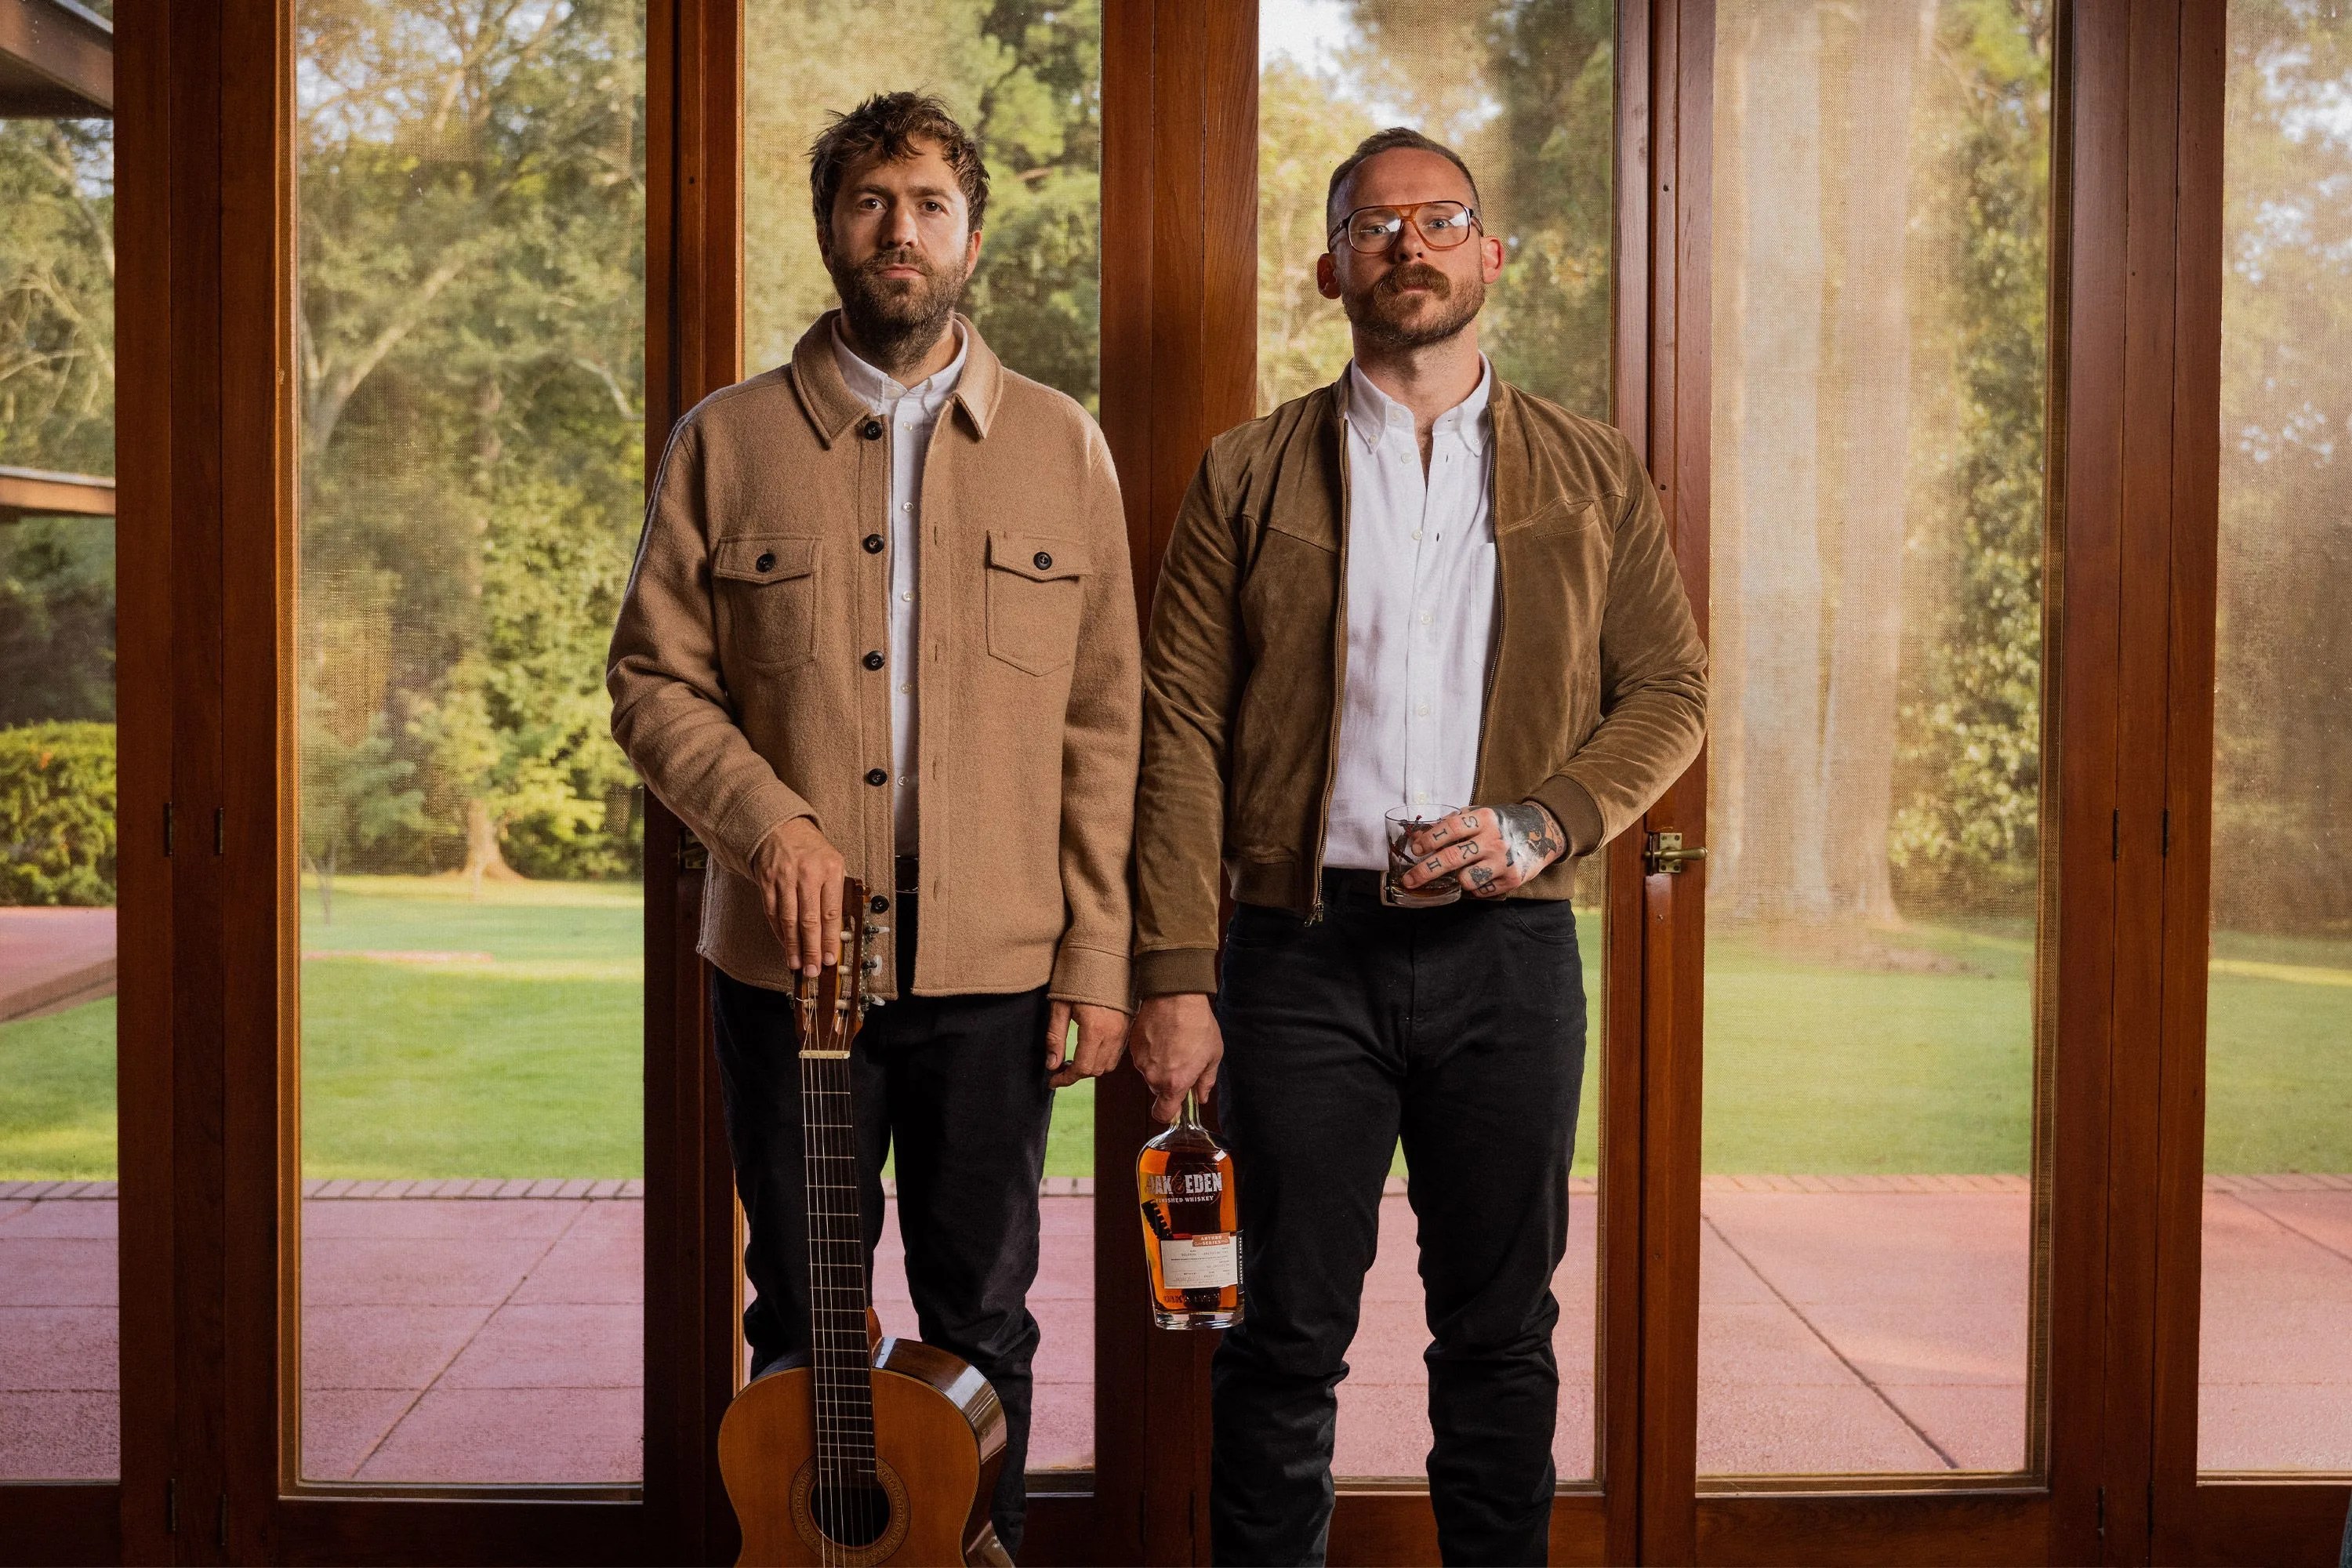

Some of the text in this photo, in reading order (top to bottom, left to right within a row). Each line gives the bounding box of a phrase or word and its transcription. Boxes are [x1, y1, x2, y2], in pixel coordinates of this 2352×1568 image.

[1462, 816, 1479, 828] S
[1457, 841, 1479, 859] R
[1185, 1172, 1222, 1194] EDEN
